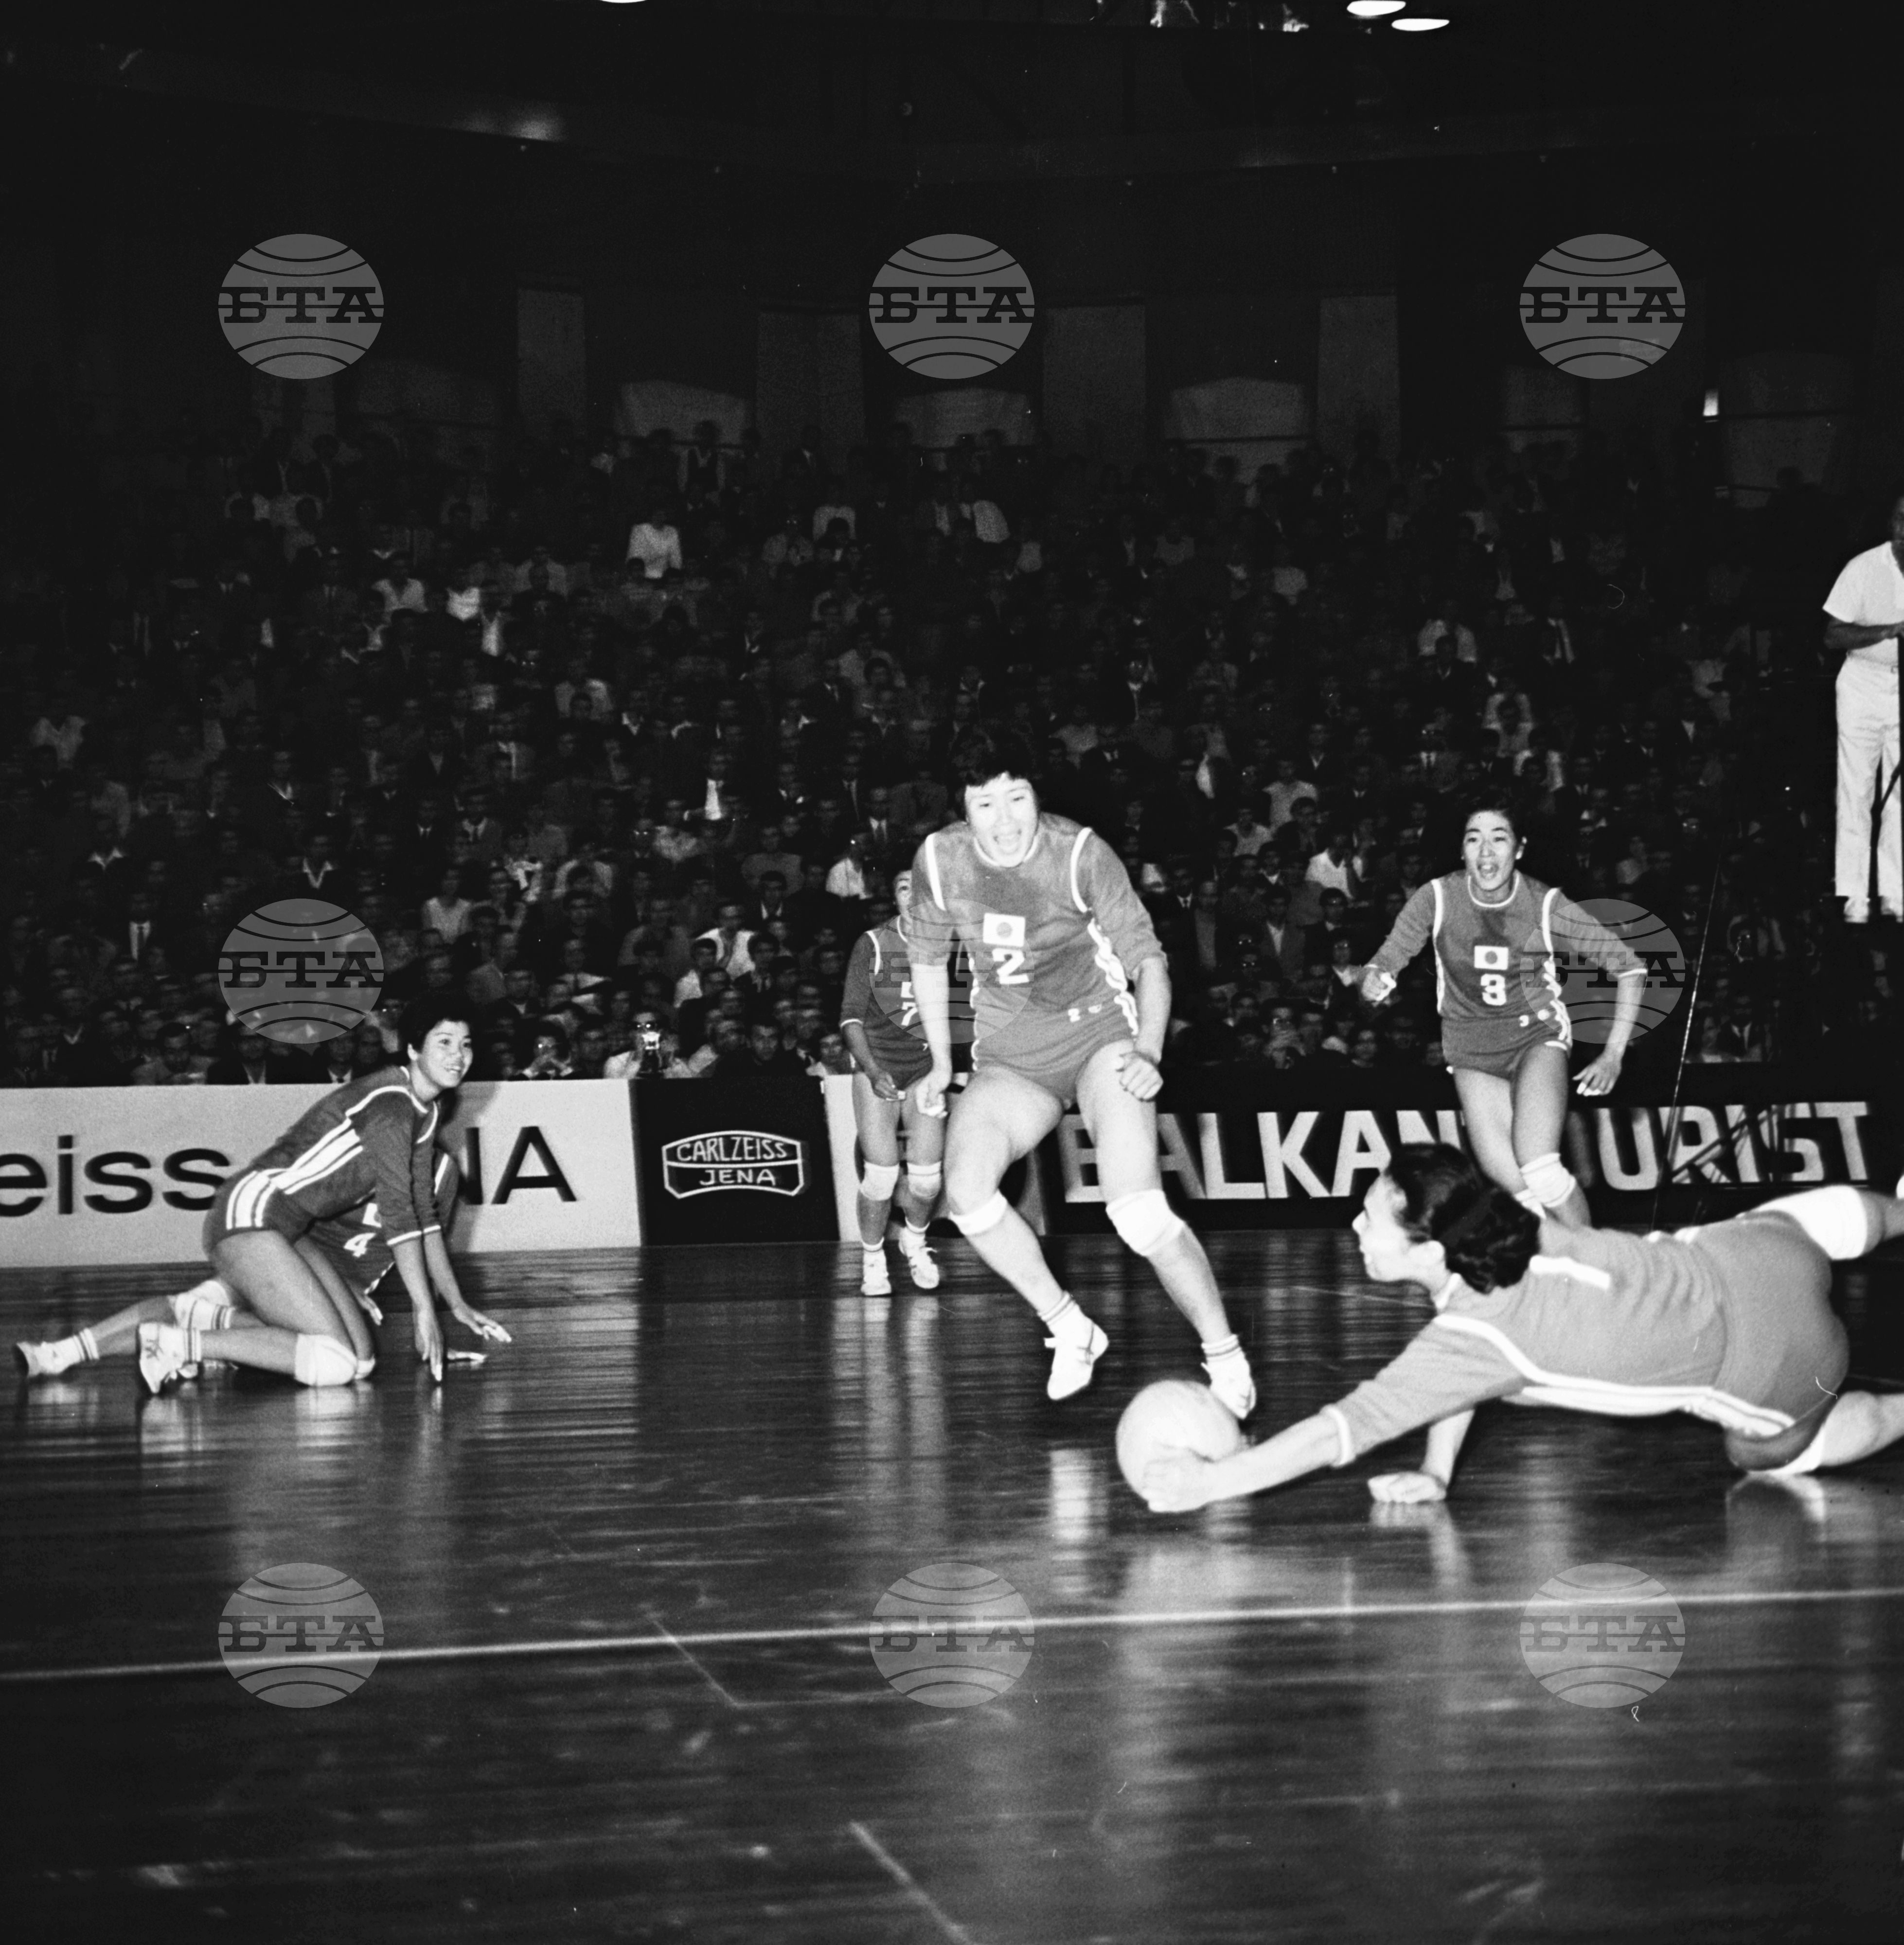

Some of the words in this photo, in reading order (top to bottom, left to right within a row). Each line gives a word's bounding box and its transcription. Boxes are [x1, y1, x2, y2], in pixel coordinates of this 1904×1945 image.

[993, 948, 1029, 985] 2
[1480, 973, 1507, 1006] 3
[901, 1002, 918, 1026] 7
[1519, 1015, 1530, 1027] 3
[699, 1168, 777, 1186] JENA
[343, 1232, 376, 1258] 4
